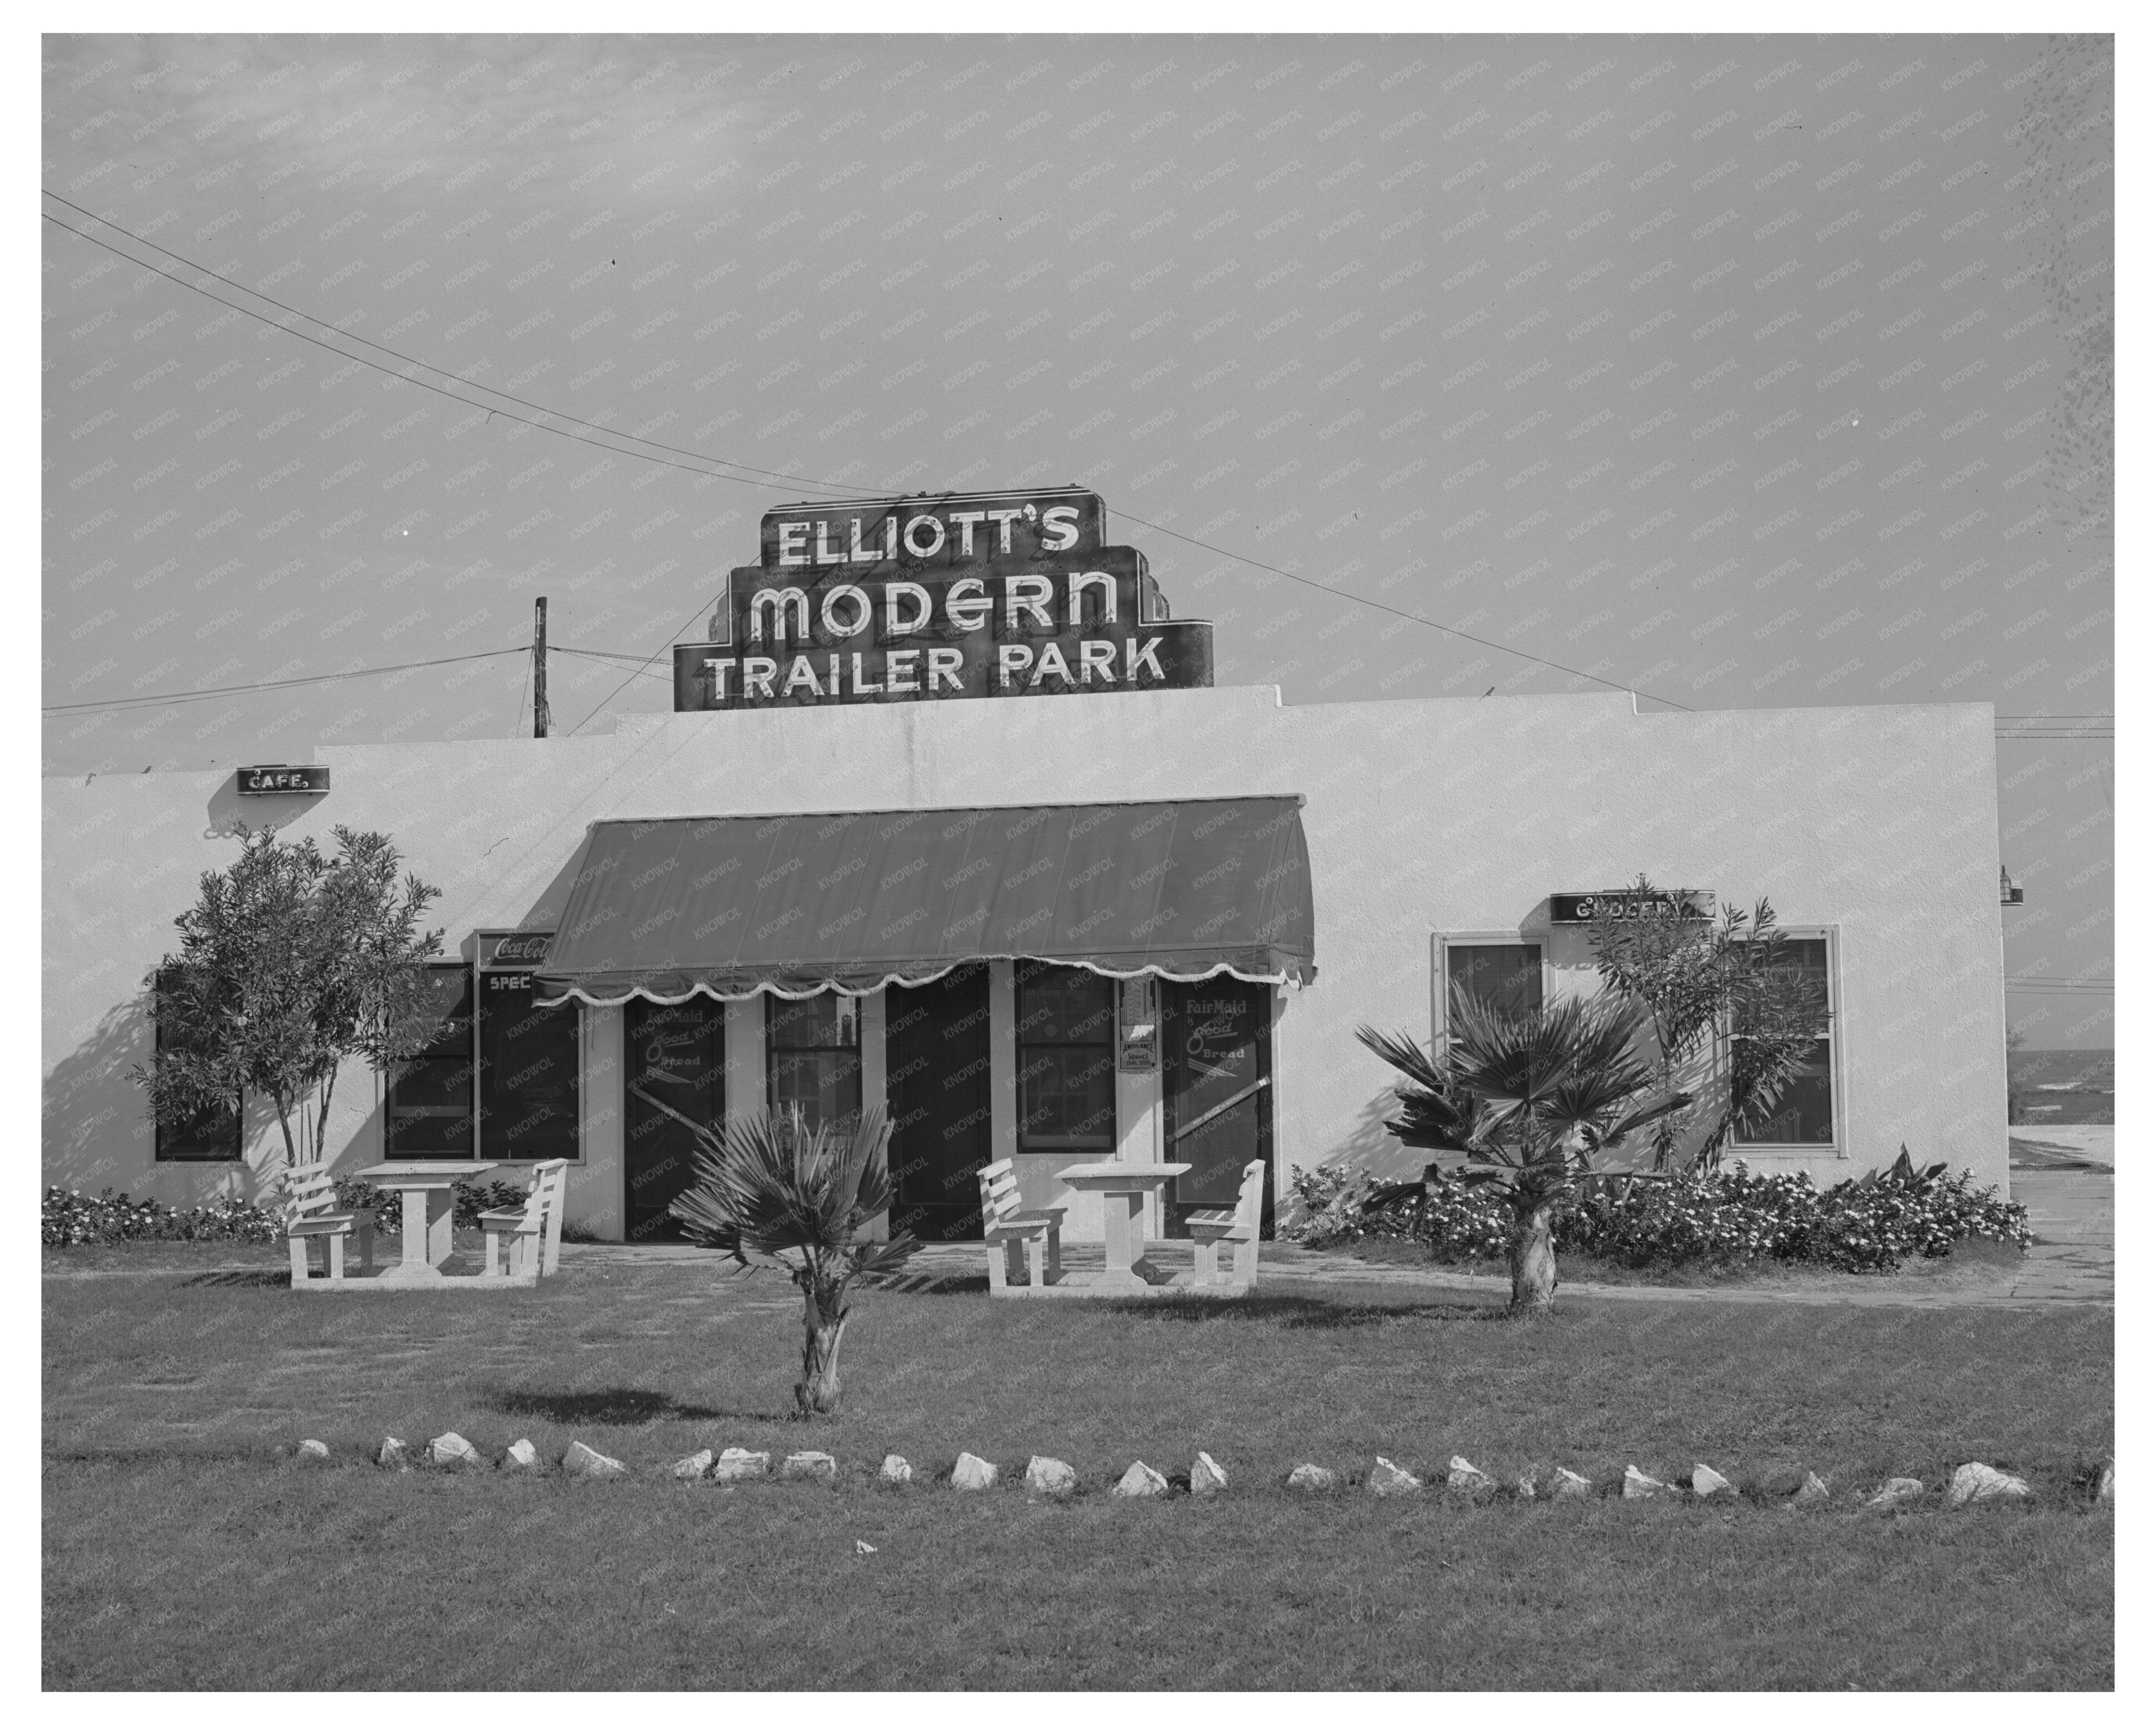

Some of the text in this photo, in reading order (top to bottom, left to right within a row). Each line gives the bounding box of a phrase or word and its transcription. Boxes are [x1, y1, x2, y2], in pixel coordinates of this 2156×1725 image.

[778, 504, 1079, 566] ELLIOTT'S
[703, 636, 1166, 700] TRAILER PARK
[490, 976, 531, 990] SPEC
[1123, 1043, 1154, 1054] AMBULANCE
[1203, 1049, 1245, 1058] Bread
[1225, 1093, 1243, 1106] BOTTLES
